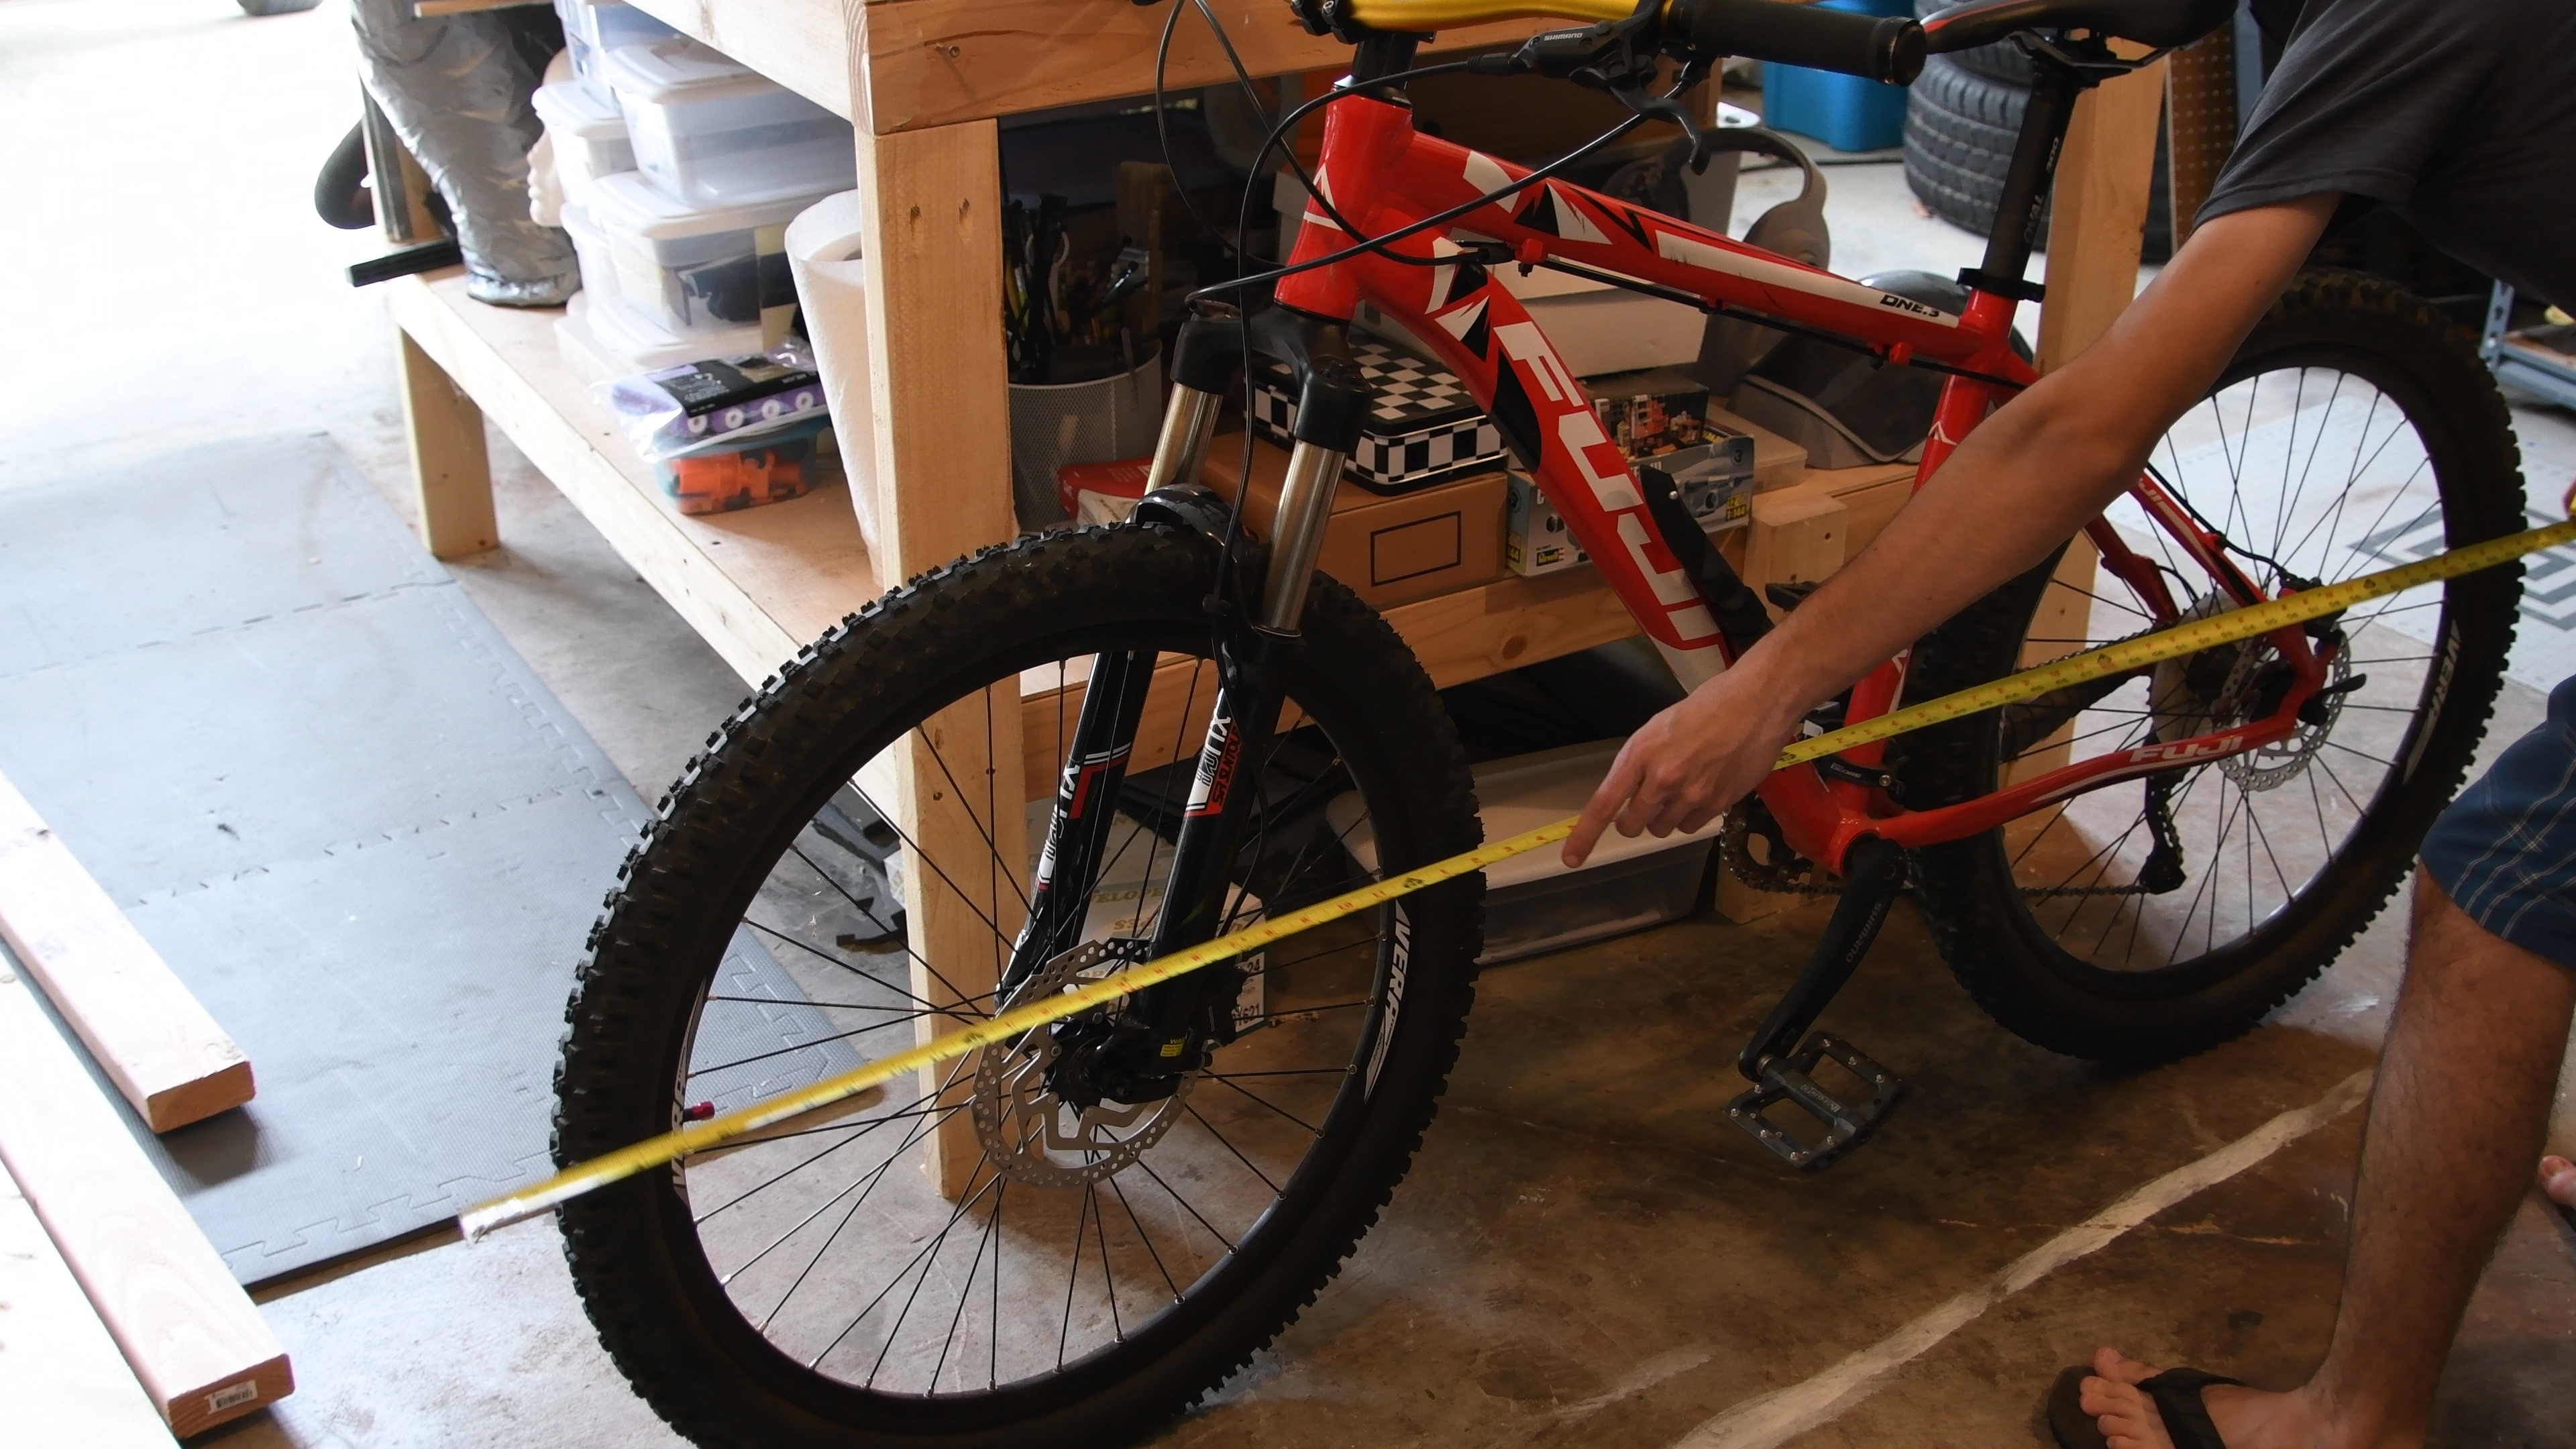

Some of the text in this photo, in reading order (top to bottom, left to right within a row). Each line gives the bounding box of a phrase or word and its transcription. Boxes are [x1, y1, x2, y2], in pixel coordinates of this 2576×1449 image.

[1544, 33, 1582, 41] SHIMANO
[1880, 294, 1940, 317] ONE.3
[1493, 321, 1721, 641] FUJI
[2129, 735, 2243, 763] FUJI
